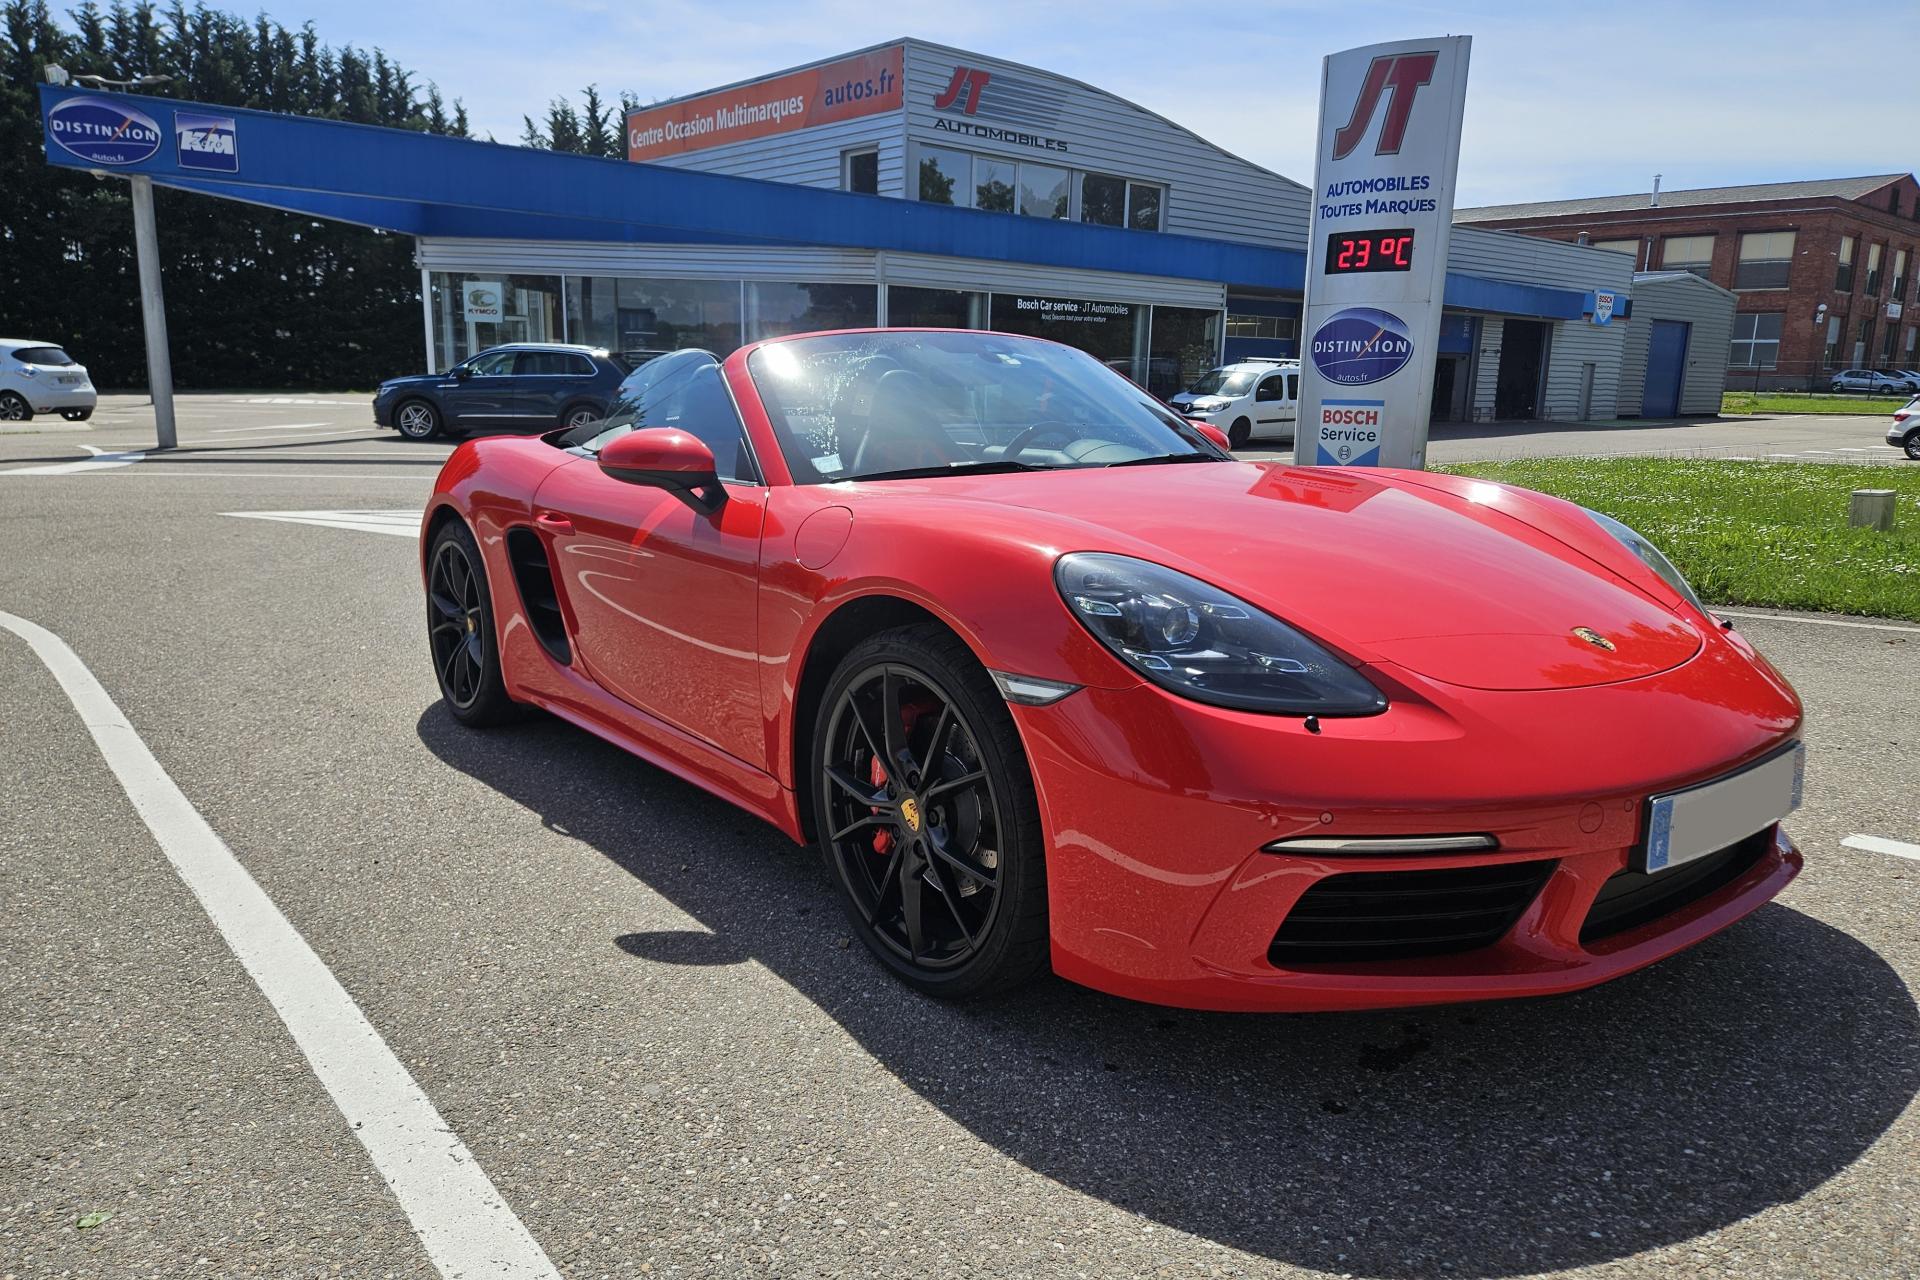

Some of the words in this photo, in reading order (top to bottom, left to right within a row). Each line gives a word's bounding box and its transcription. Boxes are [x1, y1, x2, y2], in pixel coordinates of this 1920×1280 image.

[825, 68, 895, 107] autos.fr
[935, 65, 991, 116] JT
[1332, 51, 1440, 161] JT
[53, 118, 157, 142] DISTINXION
[630, 127, 663, 149] Centre
[665, 115, 713, 140] Occasion
[716, 95, 804, 131] Multimarques
[934, 118, 1068, 152] AUTOMOBILES
[92, 152, 125, 162] autos.fr
[1326, 176, 1430, 198] AUTOMOBILES
[1338, 240, 1371, 268] 23
[1017, 298, 1039, 310] Bosch
[1040, 299, 1052, 311] Car
[1053, 301, 1078, 312] service
[1082, 302, 1091, 313] JT
[1091, 303, 1129, 315] Automobiles
[1314, 339, 1407, 354] DISTINXION
[1336, 373, 1368, 382] autos.fr
[1322, 409, 1378, 425] BOSCH
[1320, 427, 1376, 442] Service
